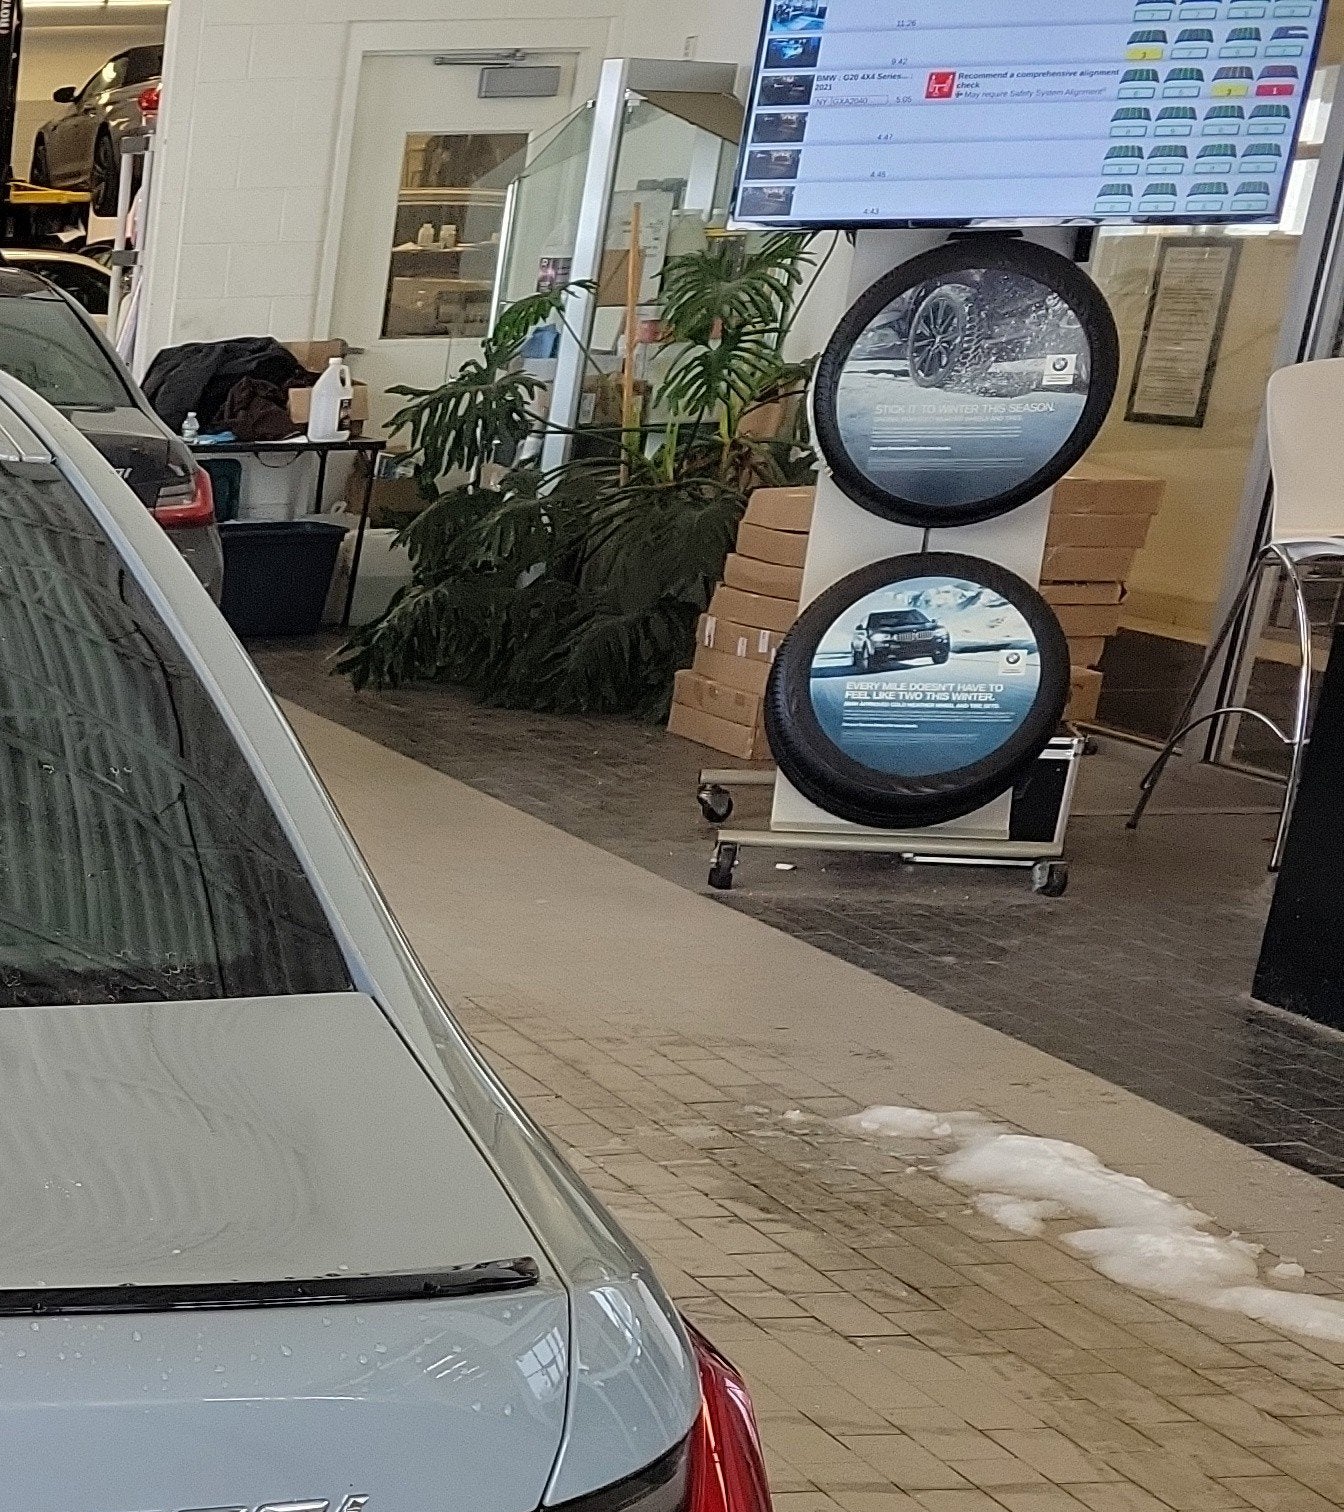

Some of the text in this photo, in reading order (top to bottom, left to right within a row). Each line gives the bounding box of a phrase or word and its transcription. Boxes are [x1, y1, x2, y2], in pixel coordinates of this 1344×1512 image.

[958, 72, 1008, 80] Recommend
[1016, 70, 1077, 79] comprehensive
[1079, 69, 1120, 78] alignment
[874, 404, 904, 415] STICK
[921, 404, 936, 414] TO
[939, 403, 979, 415] WINTER
[982, 402, 1007, 414] THIS
[846, 681, 1004, 693] EVERY MILE DOESN'T HAVE TO
[844, 691, 996, 702] FEEL LIKE TWO THIS WINTER.
